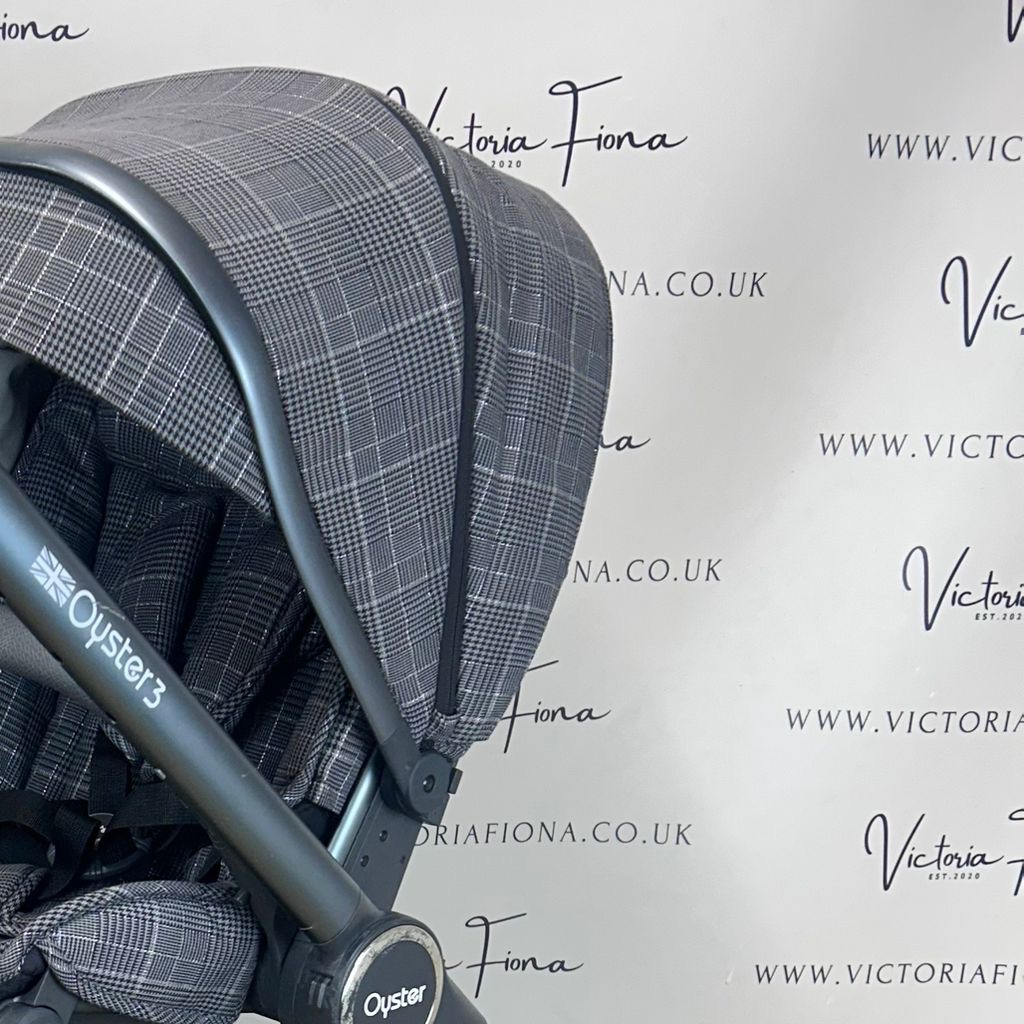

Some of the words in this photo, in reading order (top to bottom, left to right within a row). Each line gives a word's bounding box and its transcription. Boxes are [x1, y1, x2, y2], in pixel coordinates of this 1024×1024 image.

[548, 76, 688, 187] Fiona
[864, 813, 1004, 891] Victoria
[929, 873, 981, 881] EST.2020
[465, 913, 584, 999] Fiona
[364, 984, 426, 1018] Oyster
